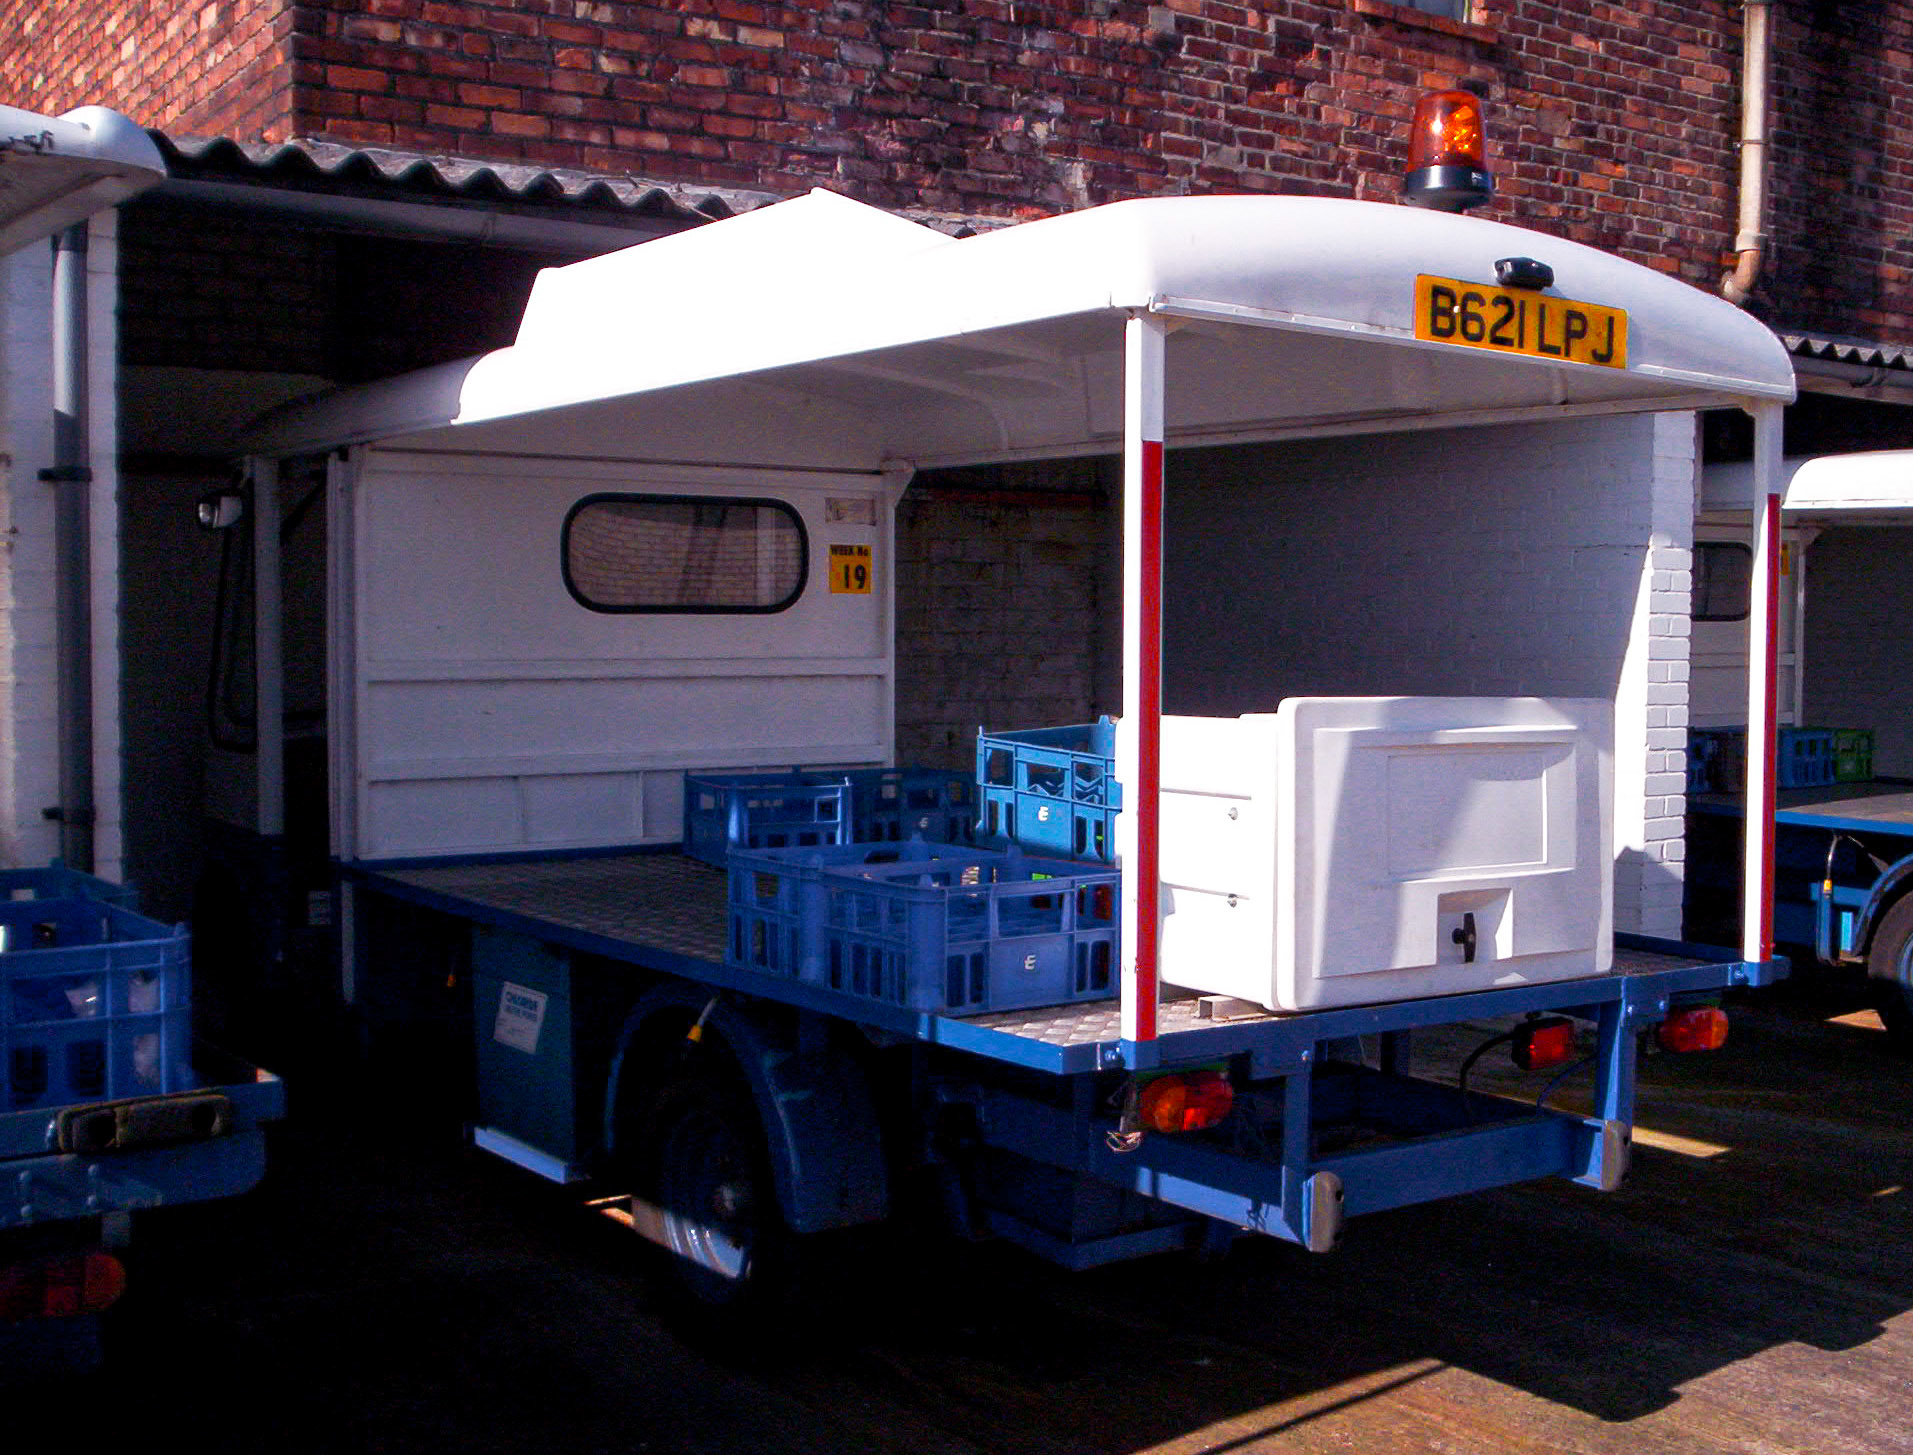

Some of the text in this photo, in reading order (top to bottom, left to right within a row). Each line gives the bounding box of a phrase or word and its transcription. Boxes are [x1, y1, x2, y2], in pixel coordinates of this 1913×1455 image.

[1431, 285, 1615, 363] B621 LPJ
[843, 564, 866, 589] 19
